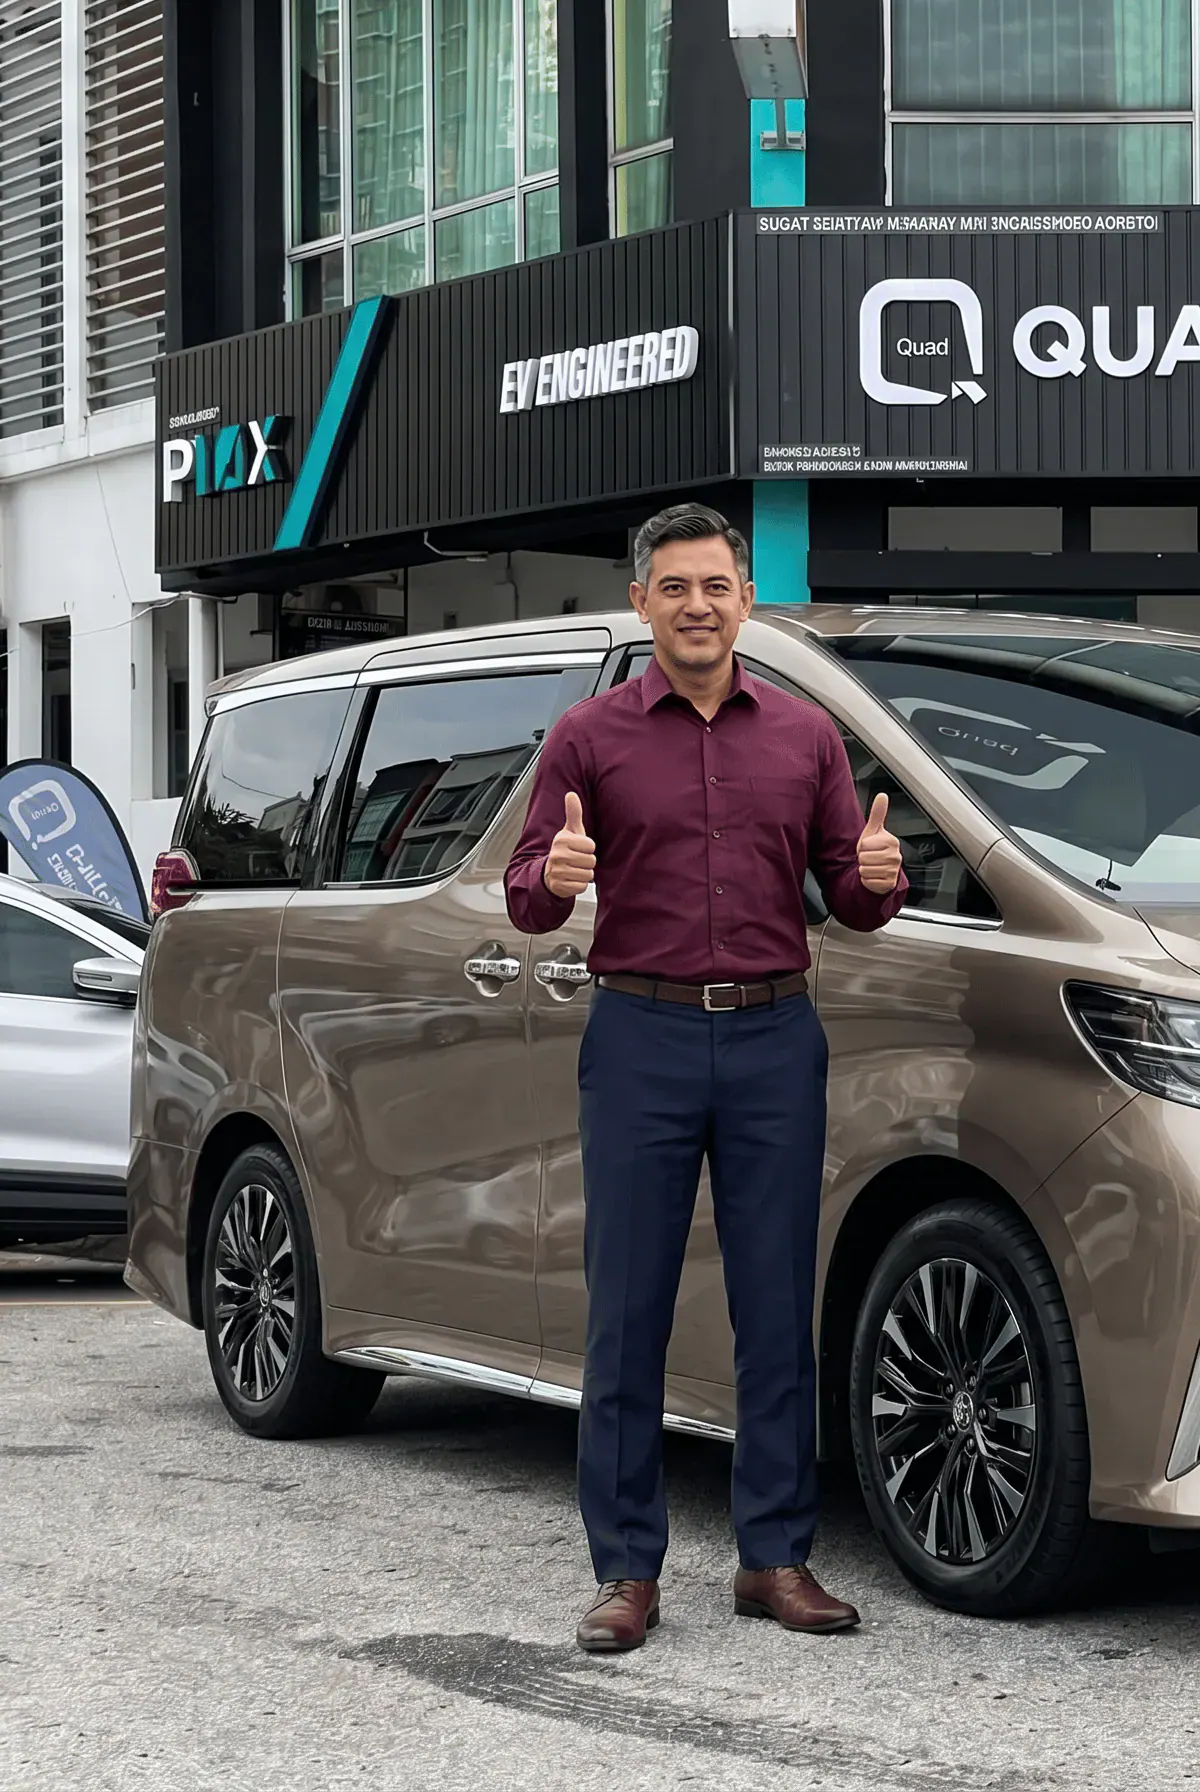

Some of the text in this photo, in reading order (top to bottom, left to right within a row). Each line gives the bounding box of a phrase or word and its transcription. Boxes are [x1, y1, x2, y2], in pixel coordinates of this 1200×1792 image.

[759, 217, 809, 231] SUGAT
[896, 337, 949, 357] Quad
[500, 326, 699, 414] EV ENGINEERED
